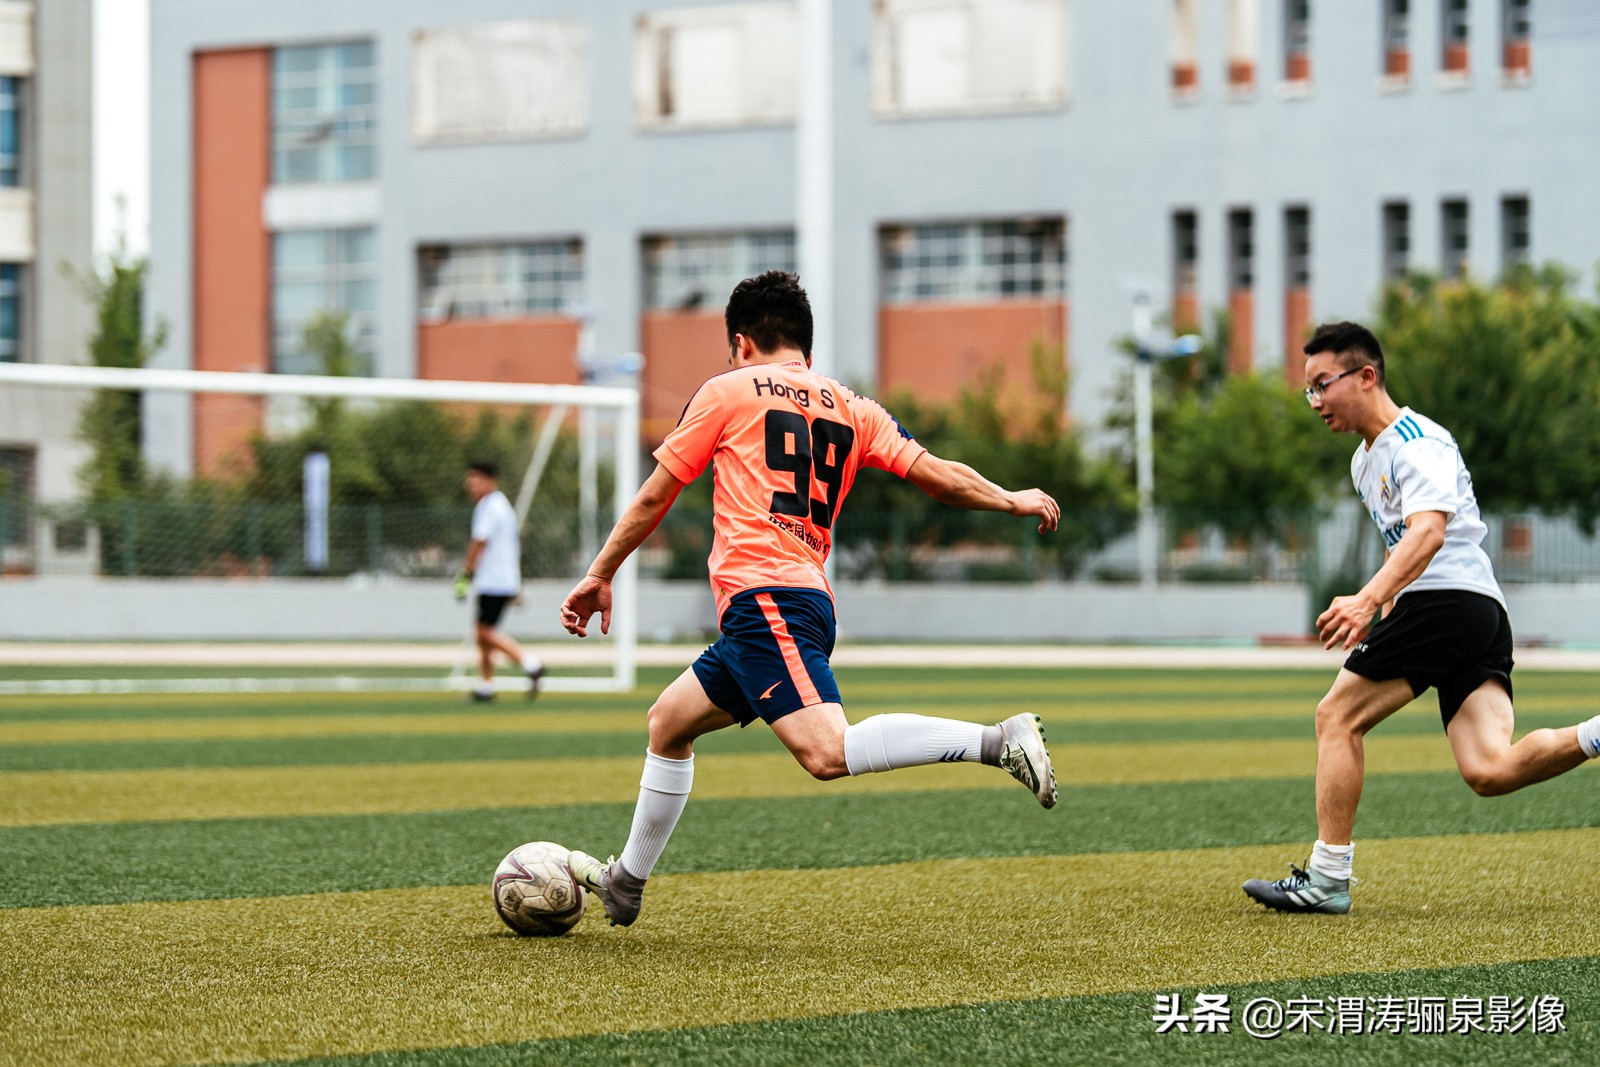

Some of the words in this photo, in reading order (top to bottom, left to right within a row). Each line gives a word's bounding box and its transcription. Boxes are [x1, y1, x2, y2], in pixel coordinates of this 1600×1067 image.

[753, 377, 809, 407] Hong
[820, 388, 835, 410] S
[765, 409, 854, 529] 99
